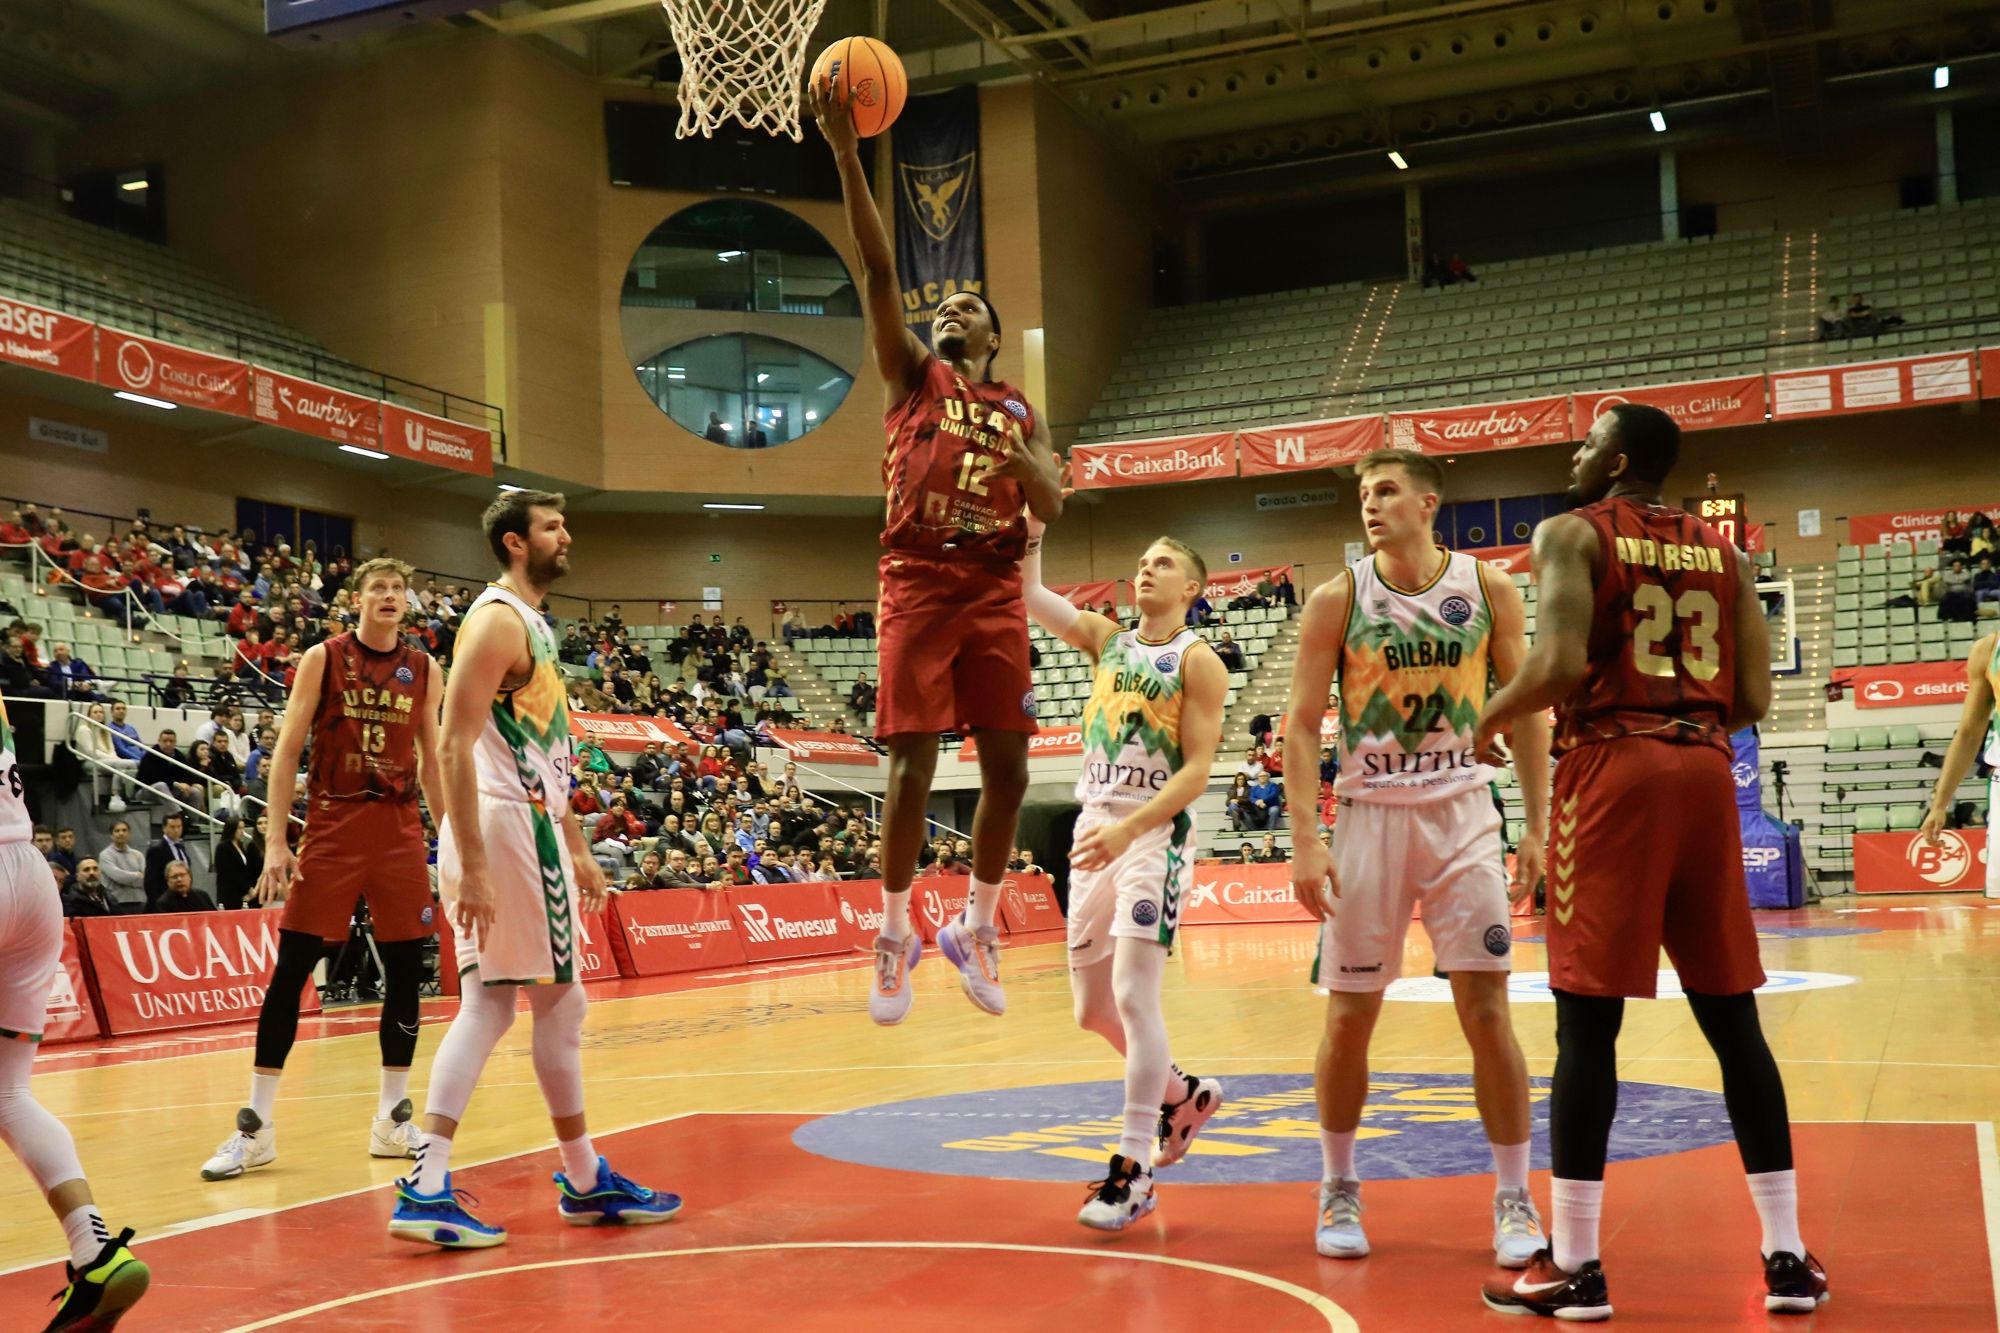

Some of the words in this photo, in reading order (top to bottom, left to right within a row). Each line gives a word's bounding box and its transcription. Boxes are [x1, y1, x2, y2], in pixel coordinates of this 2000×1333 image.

[159, 363, 195, 386] Costa
[1688, 396, 1742, 414] Cálida
[957, 451, 994, 497] 12
[1113, 446, 1226, 477] CaixaBank
[1258, 494, 1297, 508] Grada
[1701, 500, 1736, 517] 6:34
[1632, 583, 1720, 682] 23
[1383, 640, 1463, 672] BILBAO
[342, 688, 413, 713] UCAM
[1403, 693, 1445, 734] 22
[361, 723, 385, 753] 13
[1362, 746, 1476, 777] surne
[1088, 763, 1168, 792] surne
[644, 923, 691, 937] ESTRELLA
[695, 920, 733, 933] LEVANTE
[772, 917, 838, 941] Renesur
[112, 921, 279, 985] UCAM
